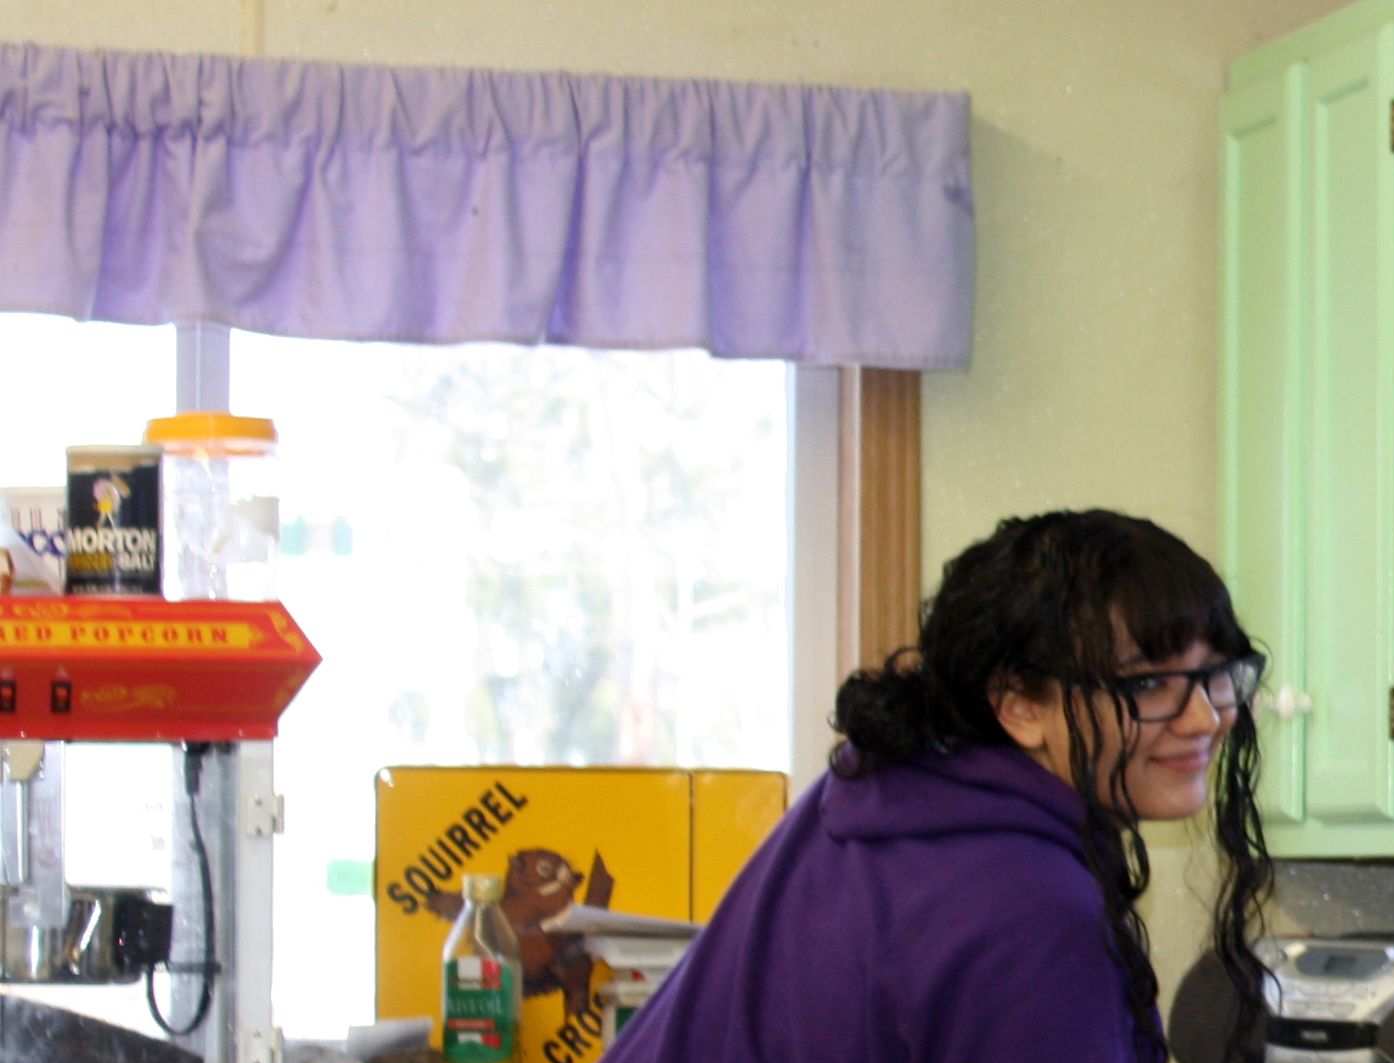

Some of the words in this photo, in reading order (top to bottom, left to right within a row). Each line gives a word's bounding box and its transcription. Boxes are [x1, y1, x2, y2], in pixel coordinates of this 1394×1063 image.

[67, 526, 157, 553] MORTON
[70, 626, 229, 643] POPCORN
[387, 779, 529, 914] SQUIRREL
